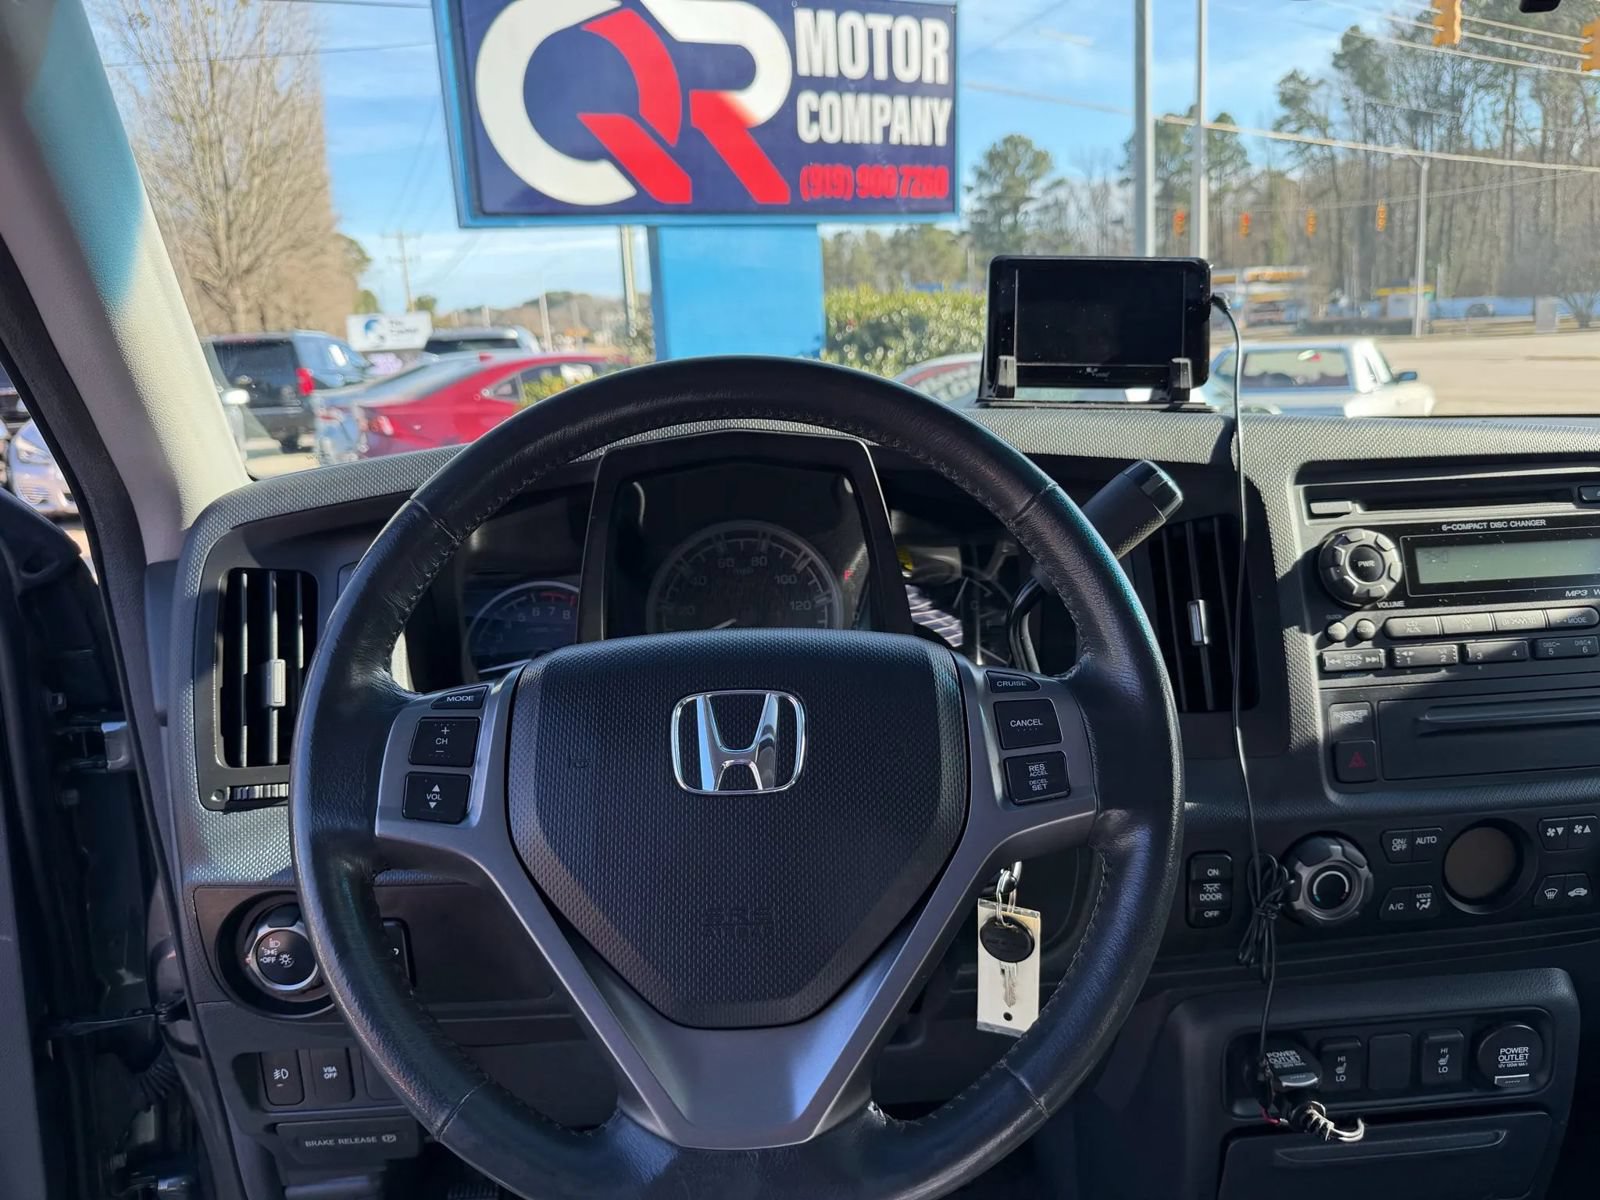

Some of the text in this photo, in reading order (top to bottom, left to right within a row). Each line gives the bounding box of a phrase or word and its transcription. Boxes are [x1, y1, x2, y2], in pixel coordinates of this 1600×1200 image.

[794, 9, 951, 85] MOTOR
[796, 91, 952, 147] COMPANY
[800, 163, 855, 201] (919)
[1490, 520, 1508, 529] DISC
[1510, 518, 1547, 528] CHANGER
[1358, 560, 1375, 568] PWR
[774, 574, 797, 585] 100
[1565, 589, 1588, 597] MP3
[790, 600, 812, 611] 120
[1377, 600, 1405, 609] VOLUME
[1567, 616, 1588, 624] MODE
[1439, 655, 1447, 663] 2
[997, 680, 1027, 688] CRUISE
[446, 694, 474, 702] MODE
[1010, 718, 1044, 728] CANCEL
[435, 737, 448, 745] CH
[1028, 763, 1046, 772] RES
[1032, 783, 1048, 791] SET
[426, 792, 442, 801] VOL
[1415, 835, 1438, 845] AUTO
[1207, 868, 1219, 876] ON
[1199, 893, 1222, 901] DOOR
[1388, 903, 1405, 911] A/C
[1203, 910, 1220, 918] OFF
[262, 956, 277, 964] OFF
[1499, 1046, 1529, 1055] POWER
[1497, 1053, 1530, 1062] OUTLET
[1438, 1066, 1449, 1074] LO
[323, 1072, 338, 1080] OFF
[304, 1136, 378, 1148] BRAKE RELEASE
